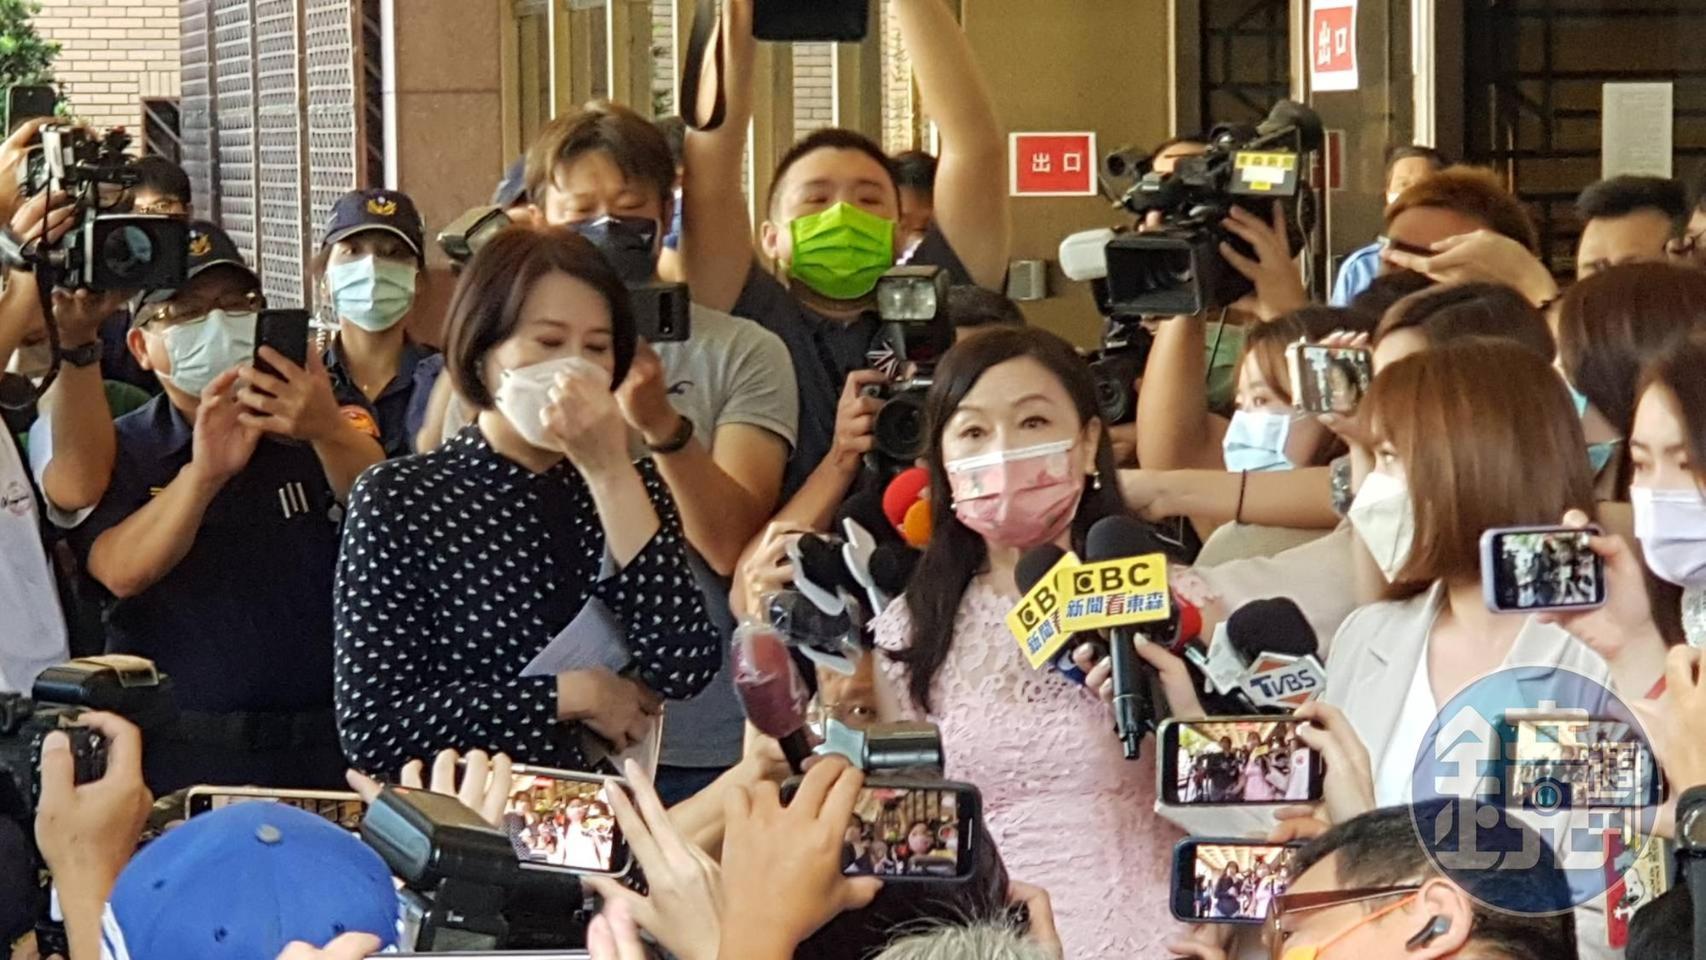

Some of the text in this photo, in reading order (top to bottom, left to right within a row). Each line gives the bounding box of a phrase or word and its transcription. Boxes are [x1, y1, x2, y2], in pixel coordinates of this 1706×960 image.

[1318, 20, 1347, 65] 出口
[1031, 151, 1082, 173] 出口
[1073, 562, 1151, 596] EBC
[1016, 572, 1059, 632] EB
[1065, 591, 1165, 618] 新聞看東森
[1249, 668, 1317, 698] TVBS
